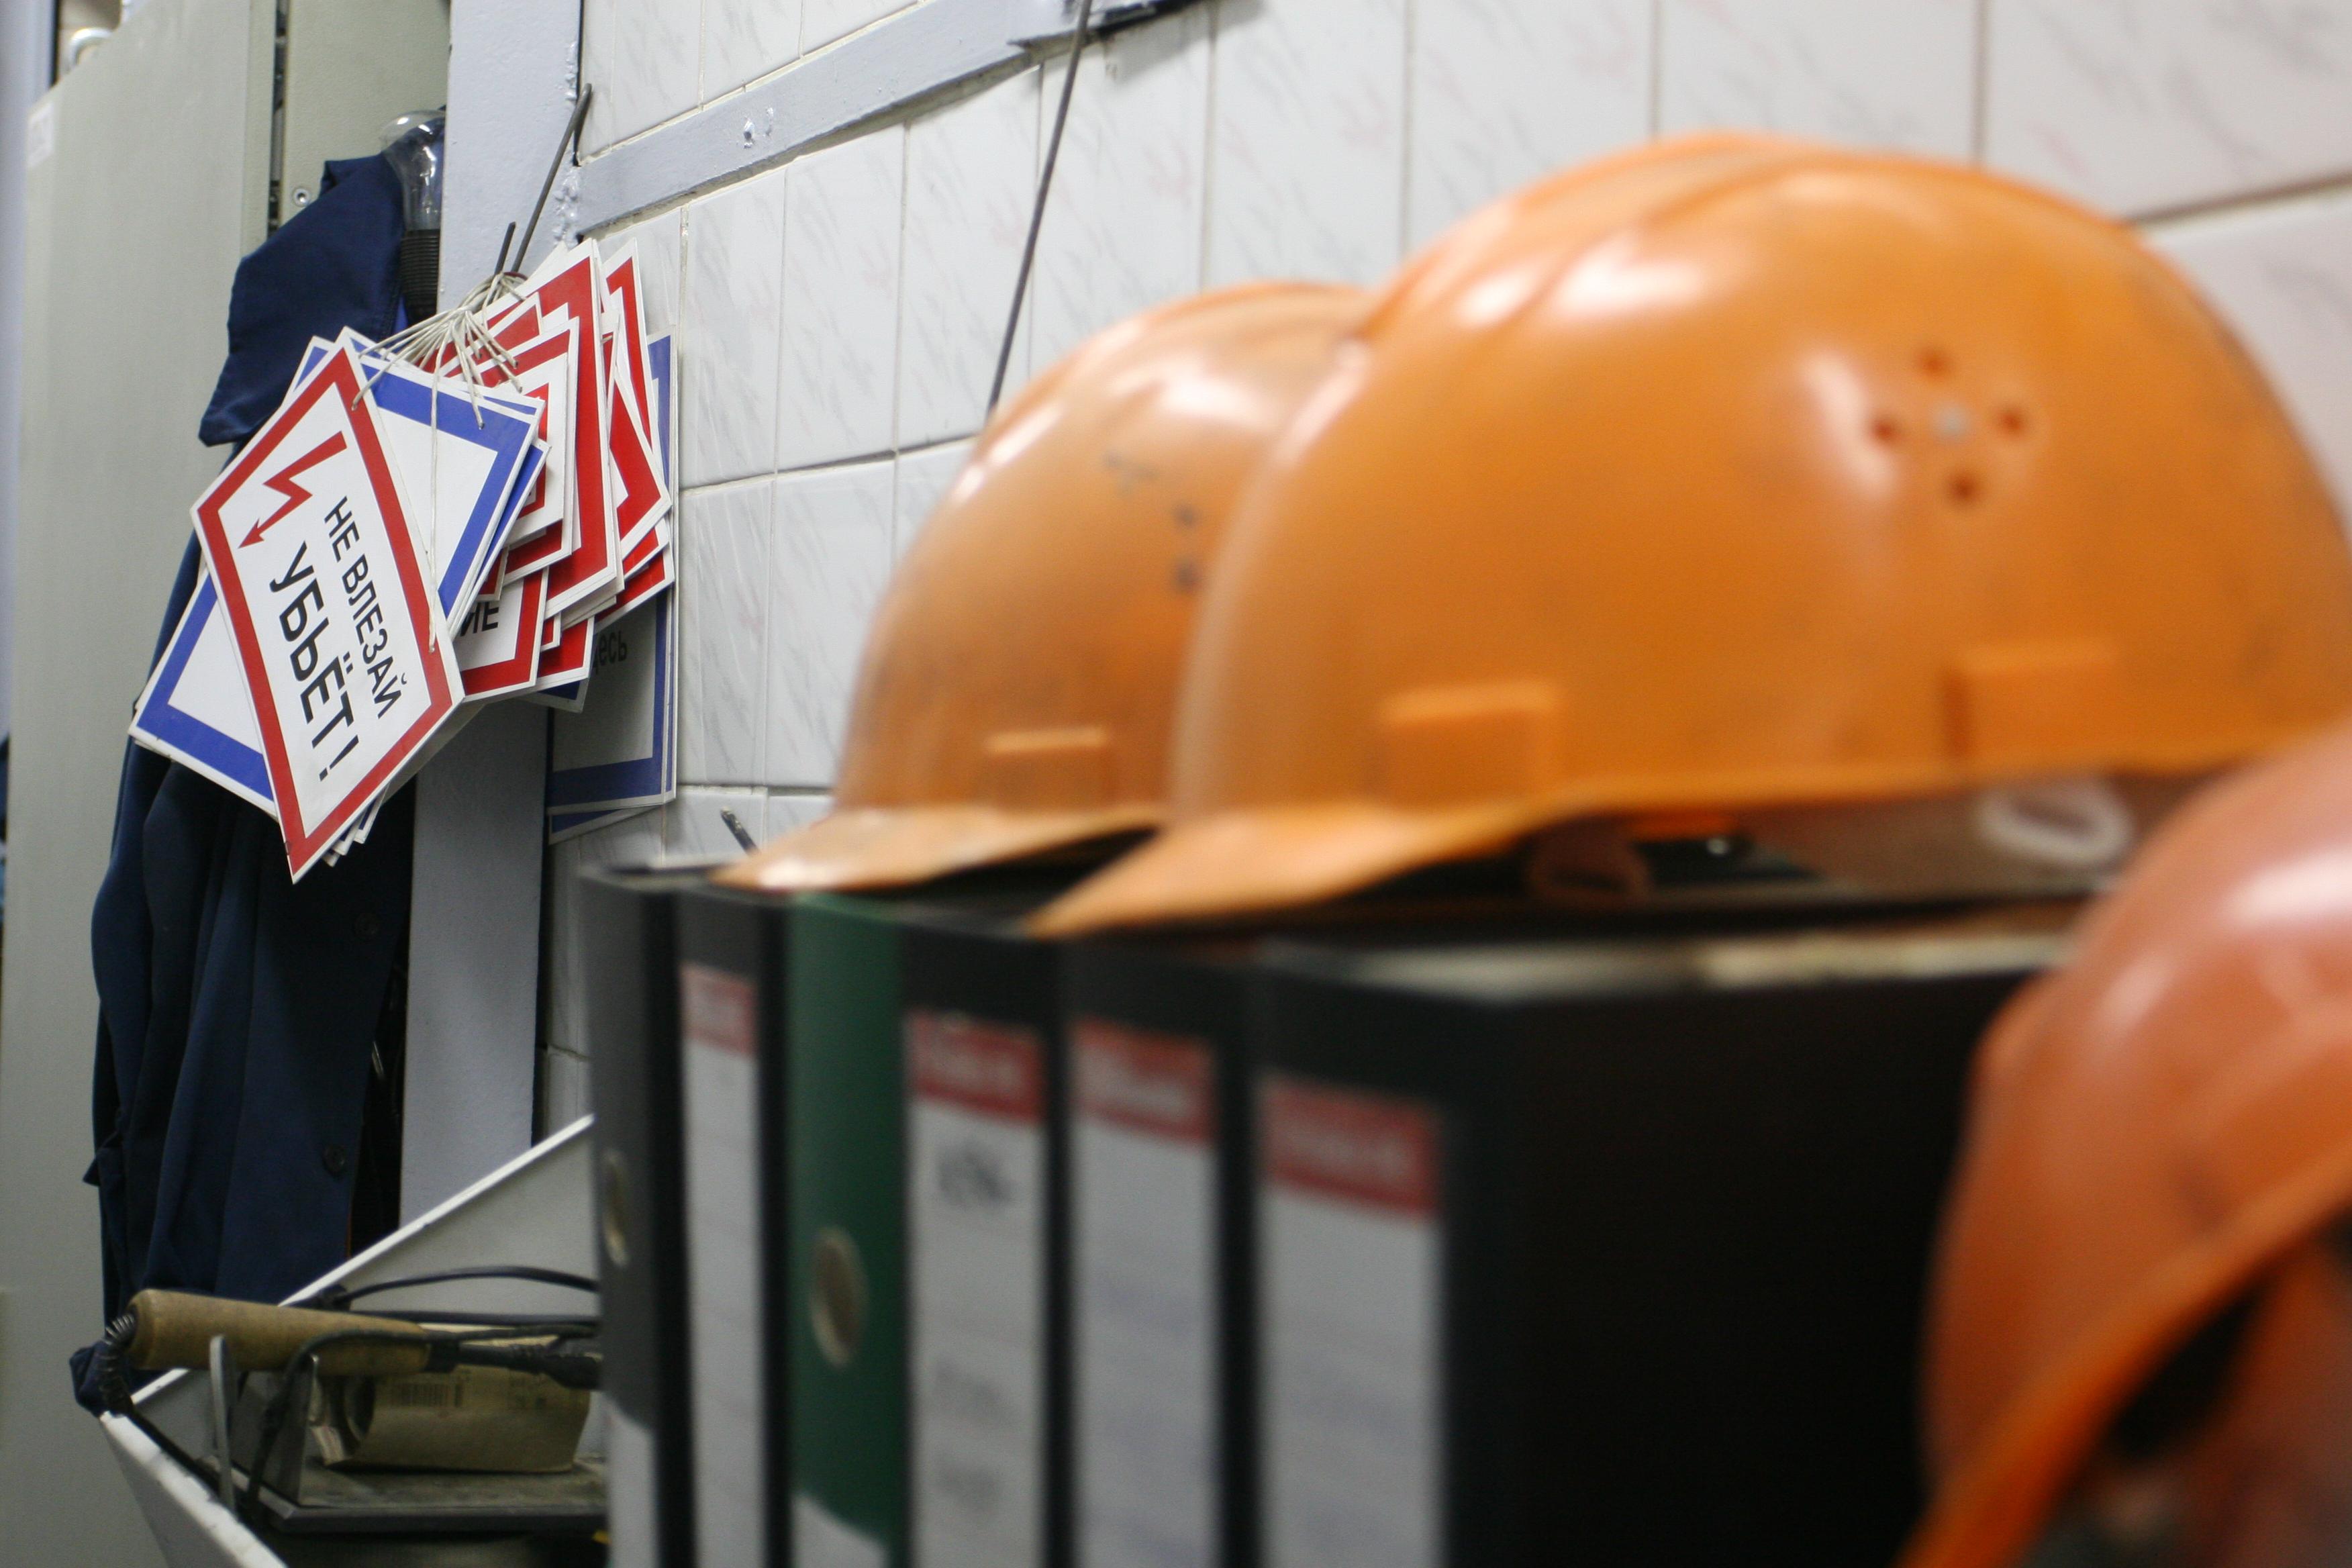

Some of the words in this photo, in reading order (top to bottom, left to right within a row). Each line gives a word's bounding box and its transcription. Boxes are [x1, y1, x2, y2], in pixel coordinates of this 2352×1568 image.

[324, 495, 360, 563] НЕ
[269, 540, 360, 782] УБЬЁТ!
[341, 553, 407, 719] ВЛЕЗАЙ
